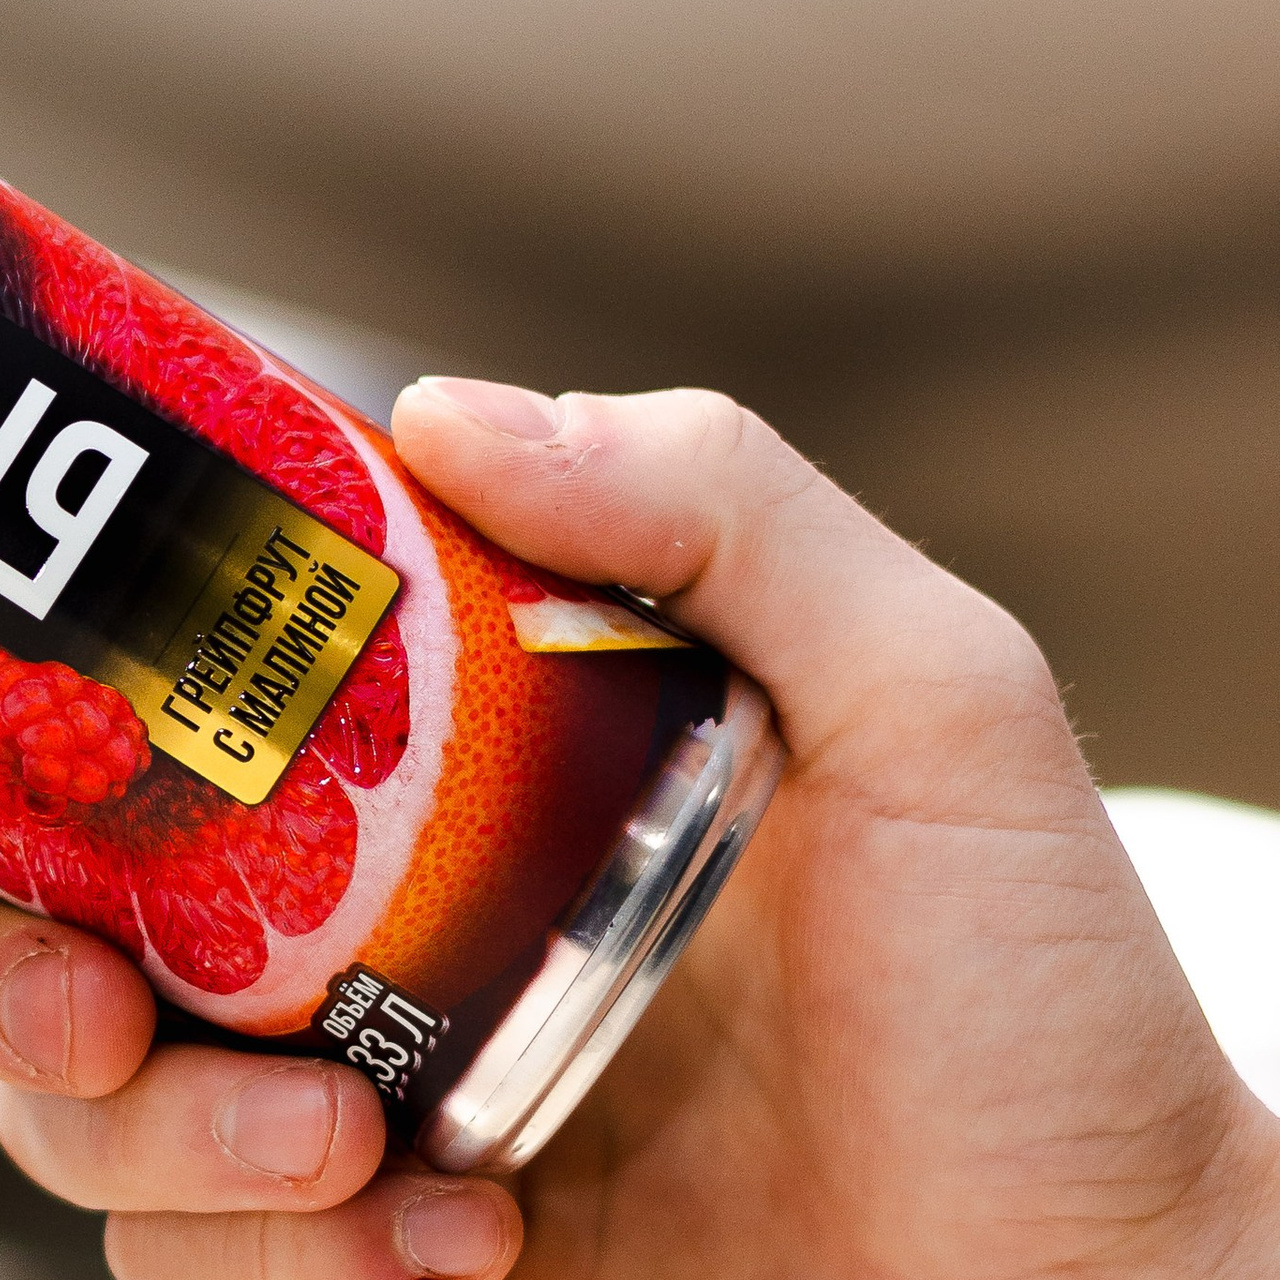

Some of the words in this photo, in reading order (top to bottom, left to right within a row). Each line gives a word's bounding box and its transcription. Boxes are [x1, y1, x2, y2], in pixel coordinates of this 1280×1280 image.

[160, 525, 311, 733] ГРЕЙПФРУТ
[228, 558, 362, 739] МАЛИНОЙ
[212, 728, 256, 764] С
[322, 972, 385, 1040] ОБЪЁМ
[346, 1027, 409, 1094] ,33
[379, 992, 437, 1045] Л
